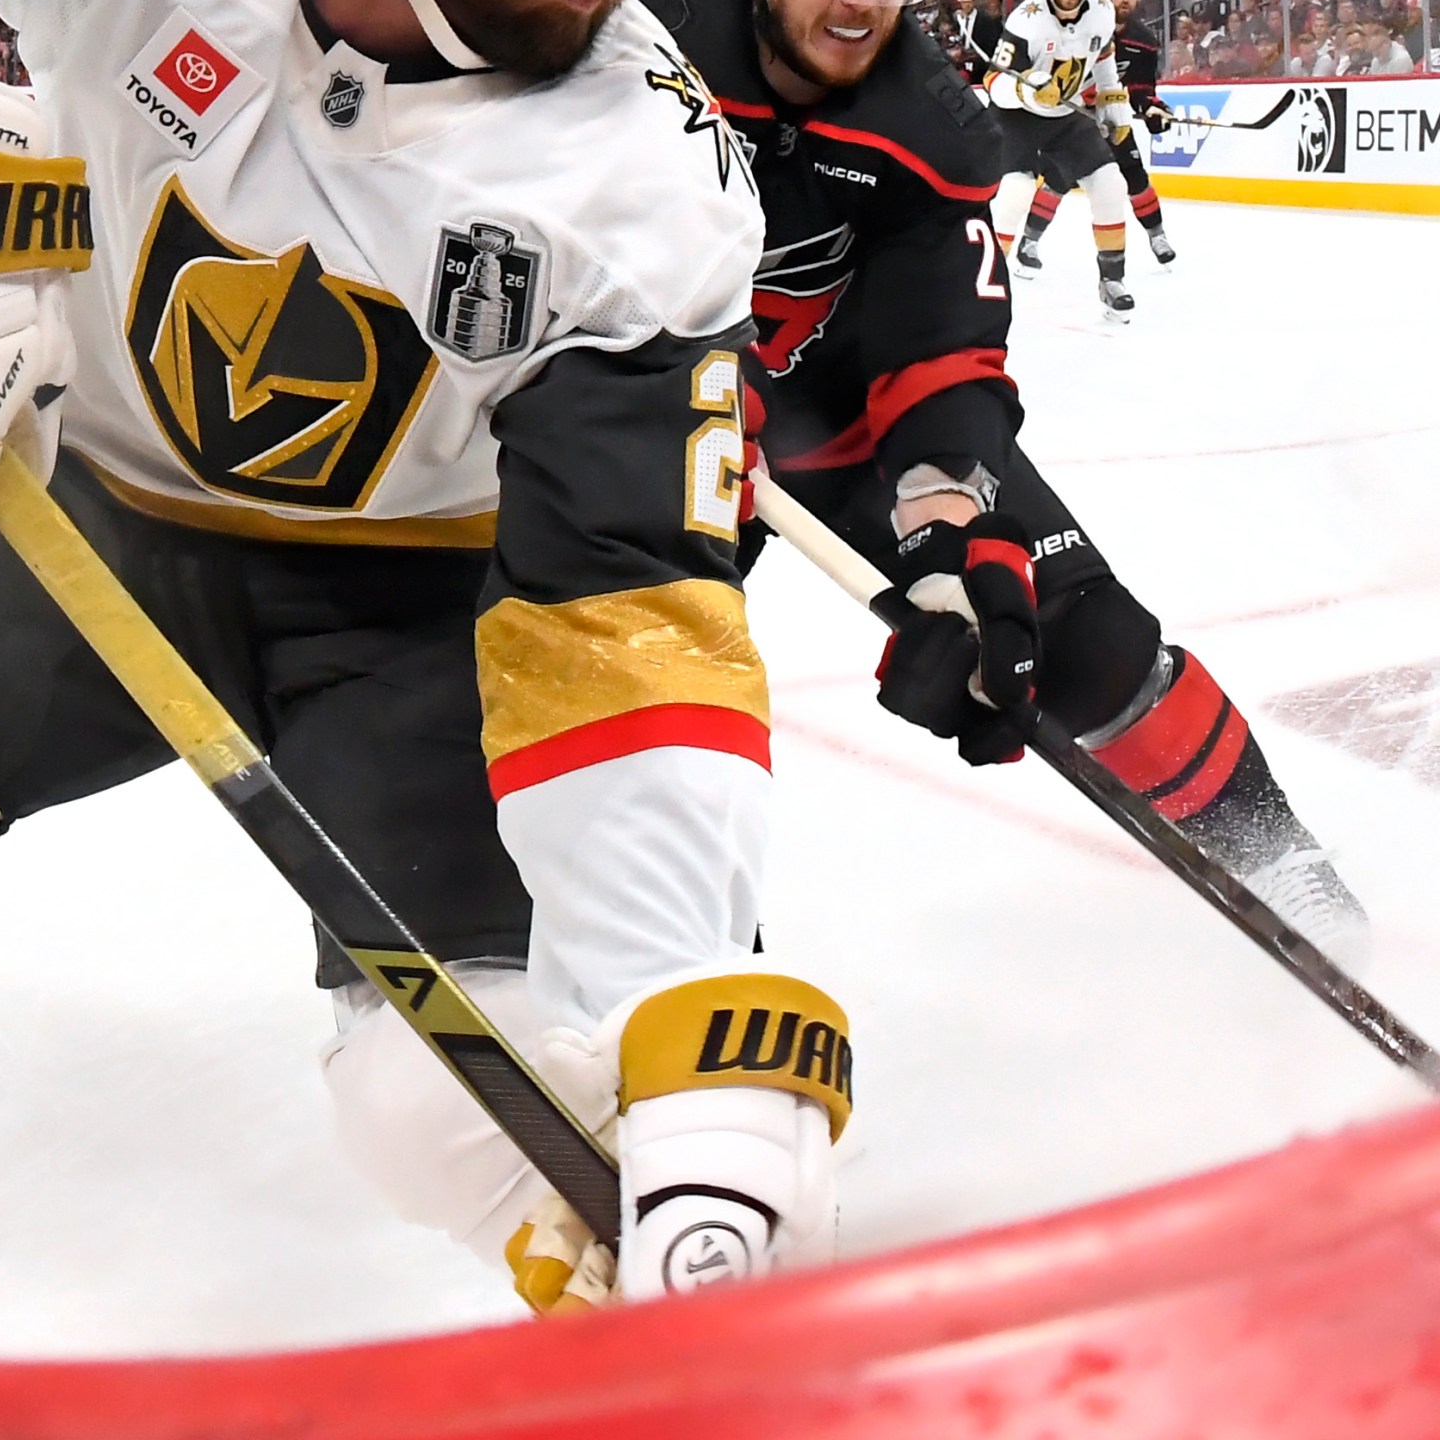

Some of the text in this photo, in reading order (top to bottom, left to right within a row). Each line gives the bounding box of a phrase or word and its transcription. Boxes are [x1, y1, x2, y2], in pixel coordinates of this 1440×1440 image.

[127, 74, 197, 150] TOYOTA
[326, 86, 358, 110] NHL
[1152, 104, 1212, 154] SAP
[1356, 109, 1440, 152] BETM
[814, 162, 877, 187] NUCOR
[446, 259, 466, 275] 20
[965, 217, 1007, 300] 2
[505, 273, 525, 288] 26
